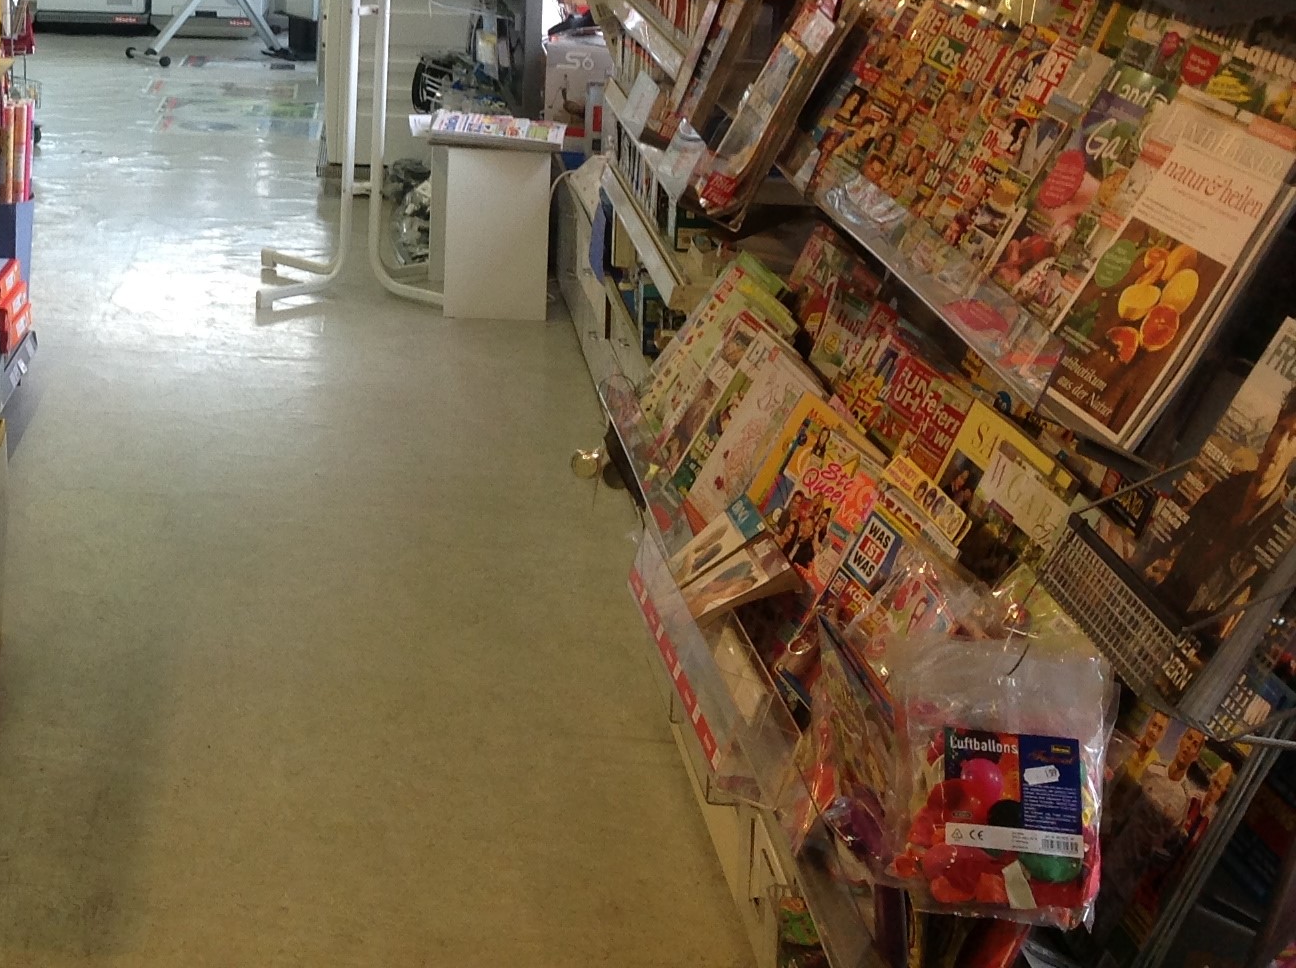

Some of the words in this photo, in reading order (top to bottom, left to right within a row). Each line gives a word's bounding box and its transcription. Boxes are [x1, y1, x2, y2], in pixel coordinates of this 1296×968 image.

[1071, 383, 1090, 401] der
[1085, 391, 1114, 418] Natur
[868, 521, 892, 550] WAS
[862, 541, 882, 560] IST
[852, 551, 876, 580] WAS
[949, 735, 1019, 755] Luftballons
